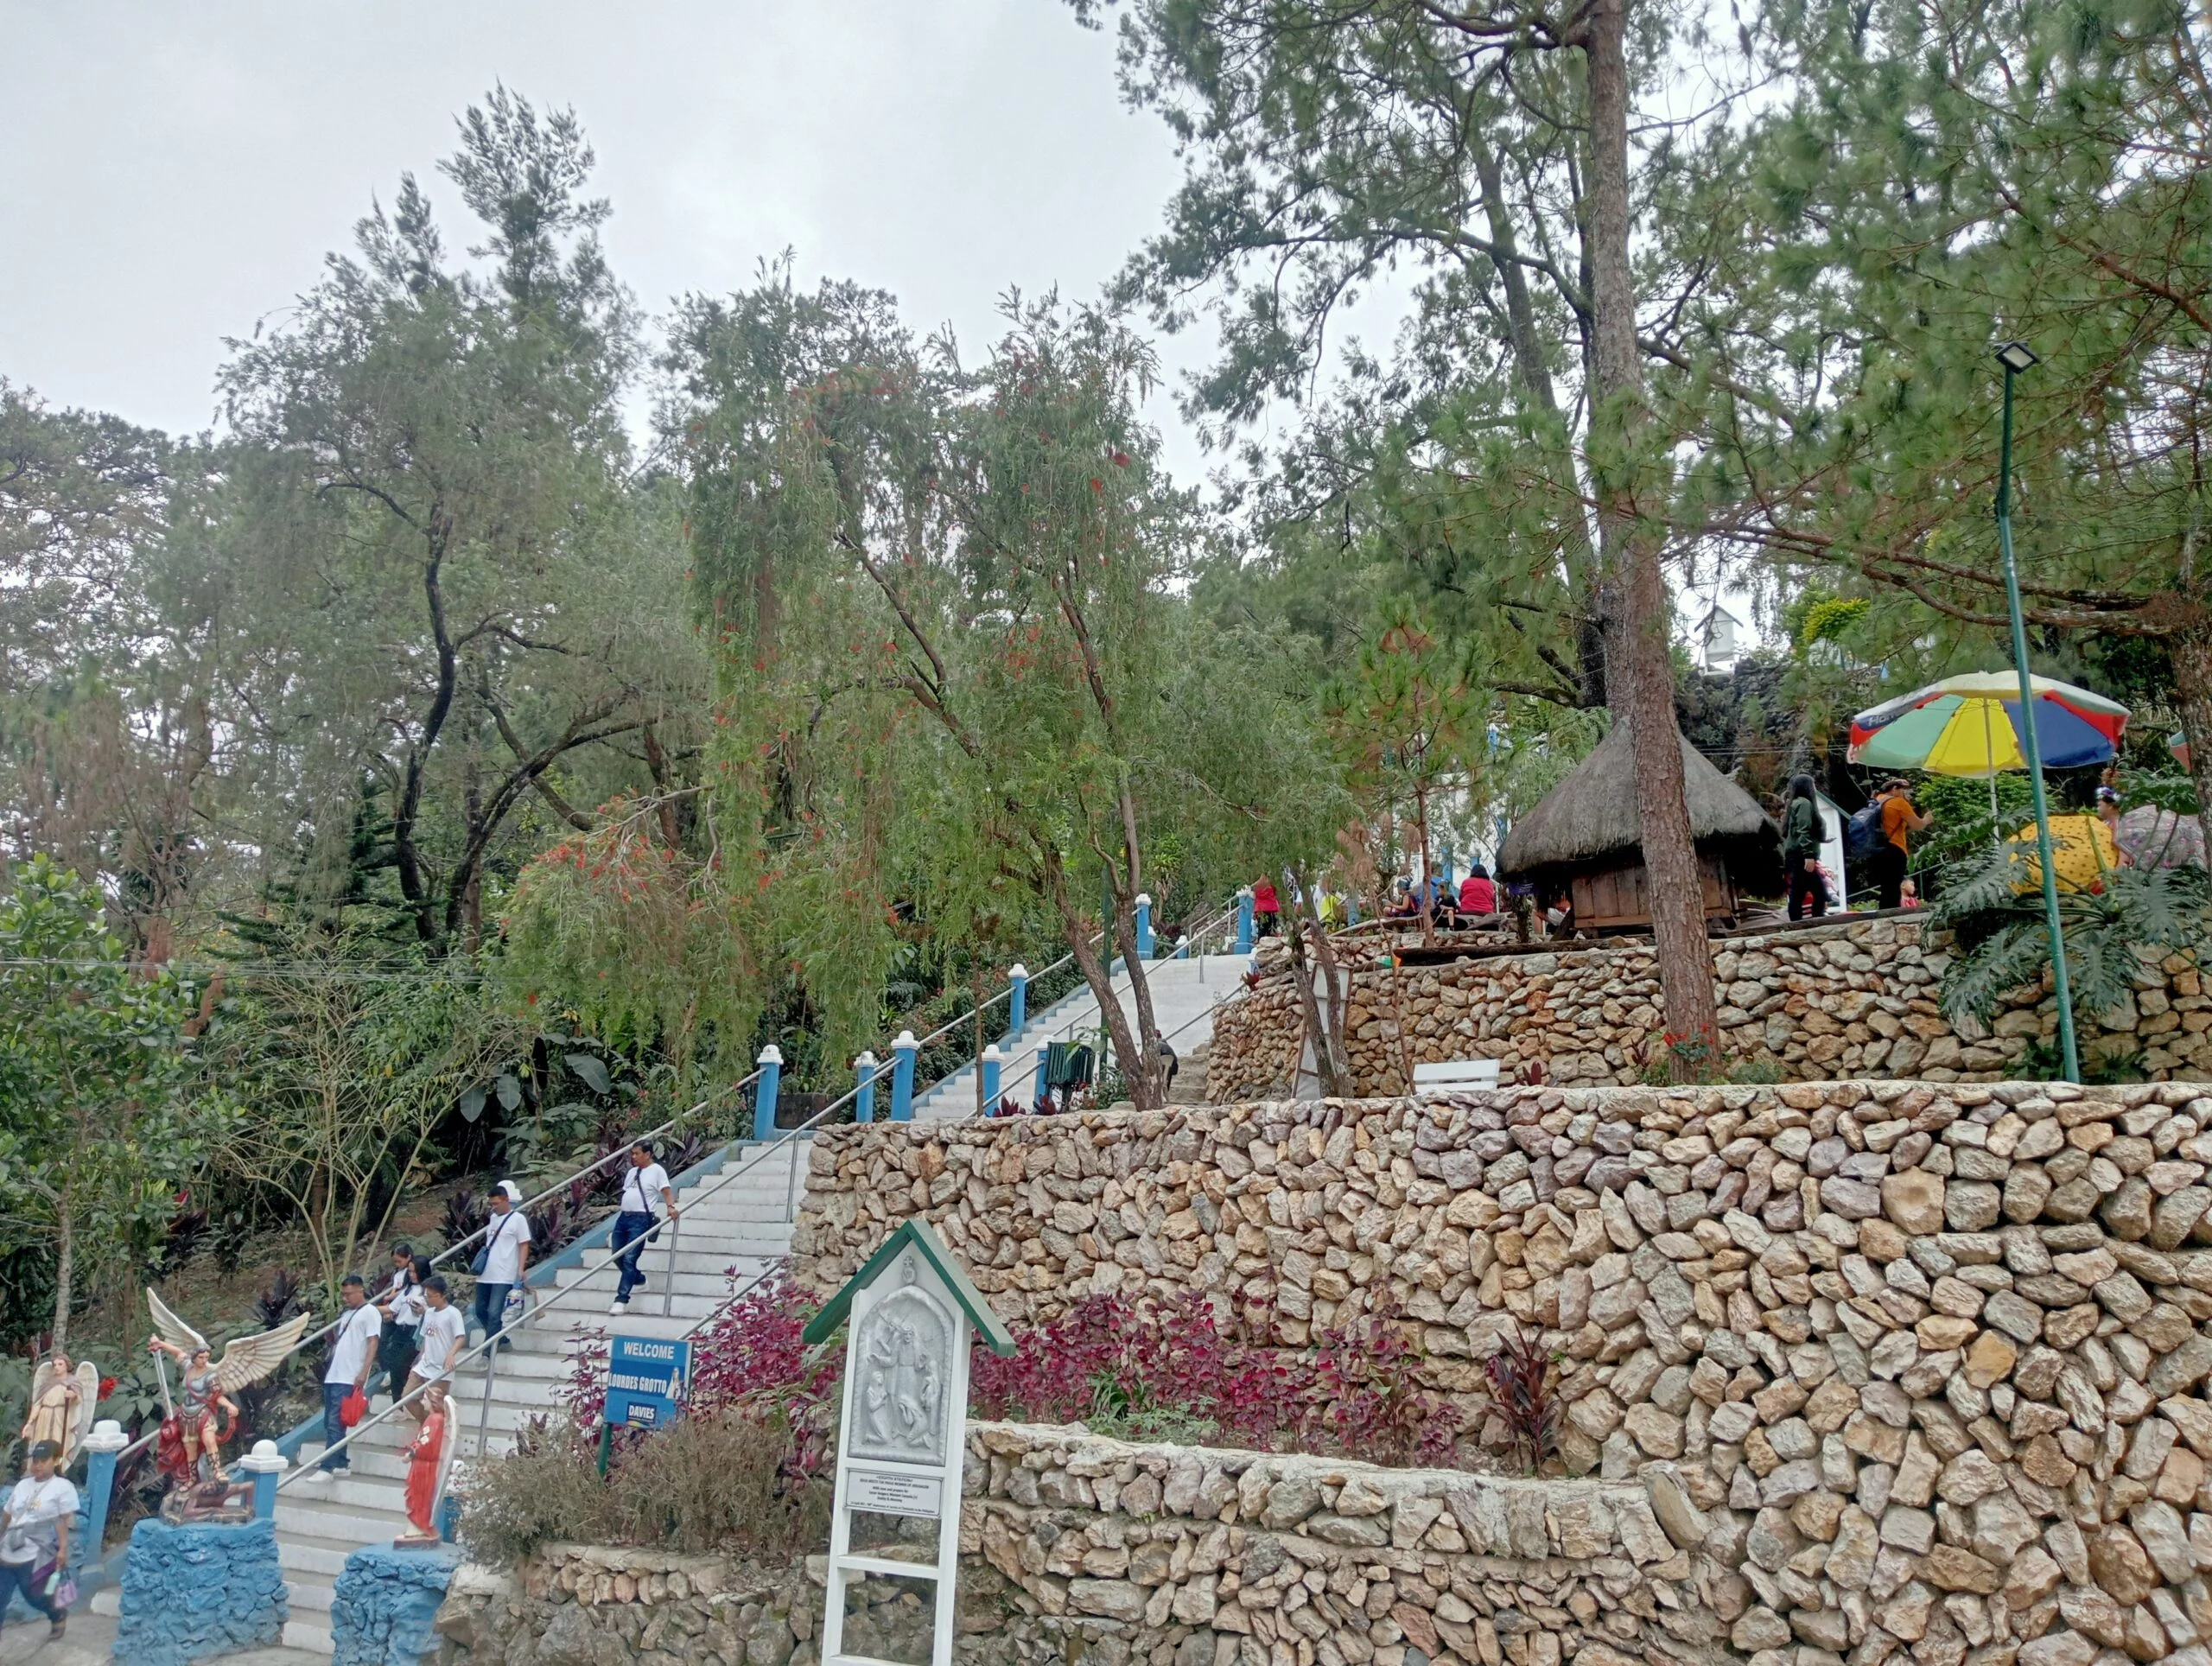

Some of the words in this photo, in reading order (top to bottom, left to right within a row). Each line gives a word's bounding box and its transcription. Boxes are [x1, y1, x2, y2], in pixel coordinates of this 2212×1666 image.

[624, 1341, 675, 1359] WELCOME
[608, 1372, 639, 1390] LOURDES
[639, 1377, 667, 1394] GROTTO
[628, 1405, 655, 1420] DAVIES
